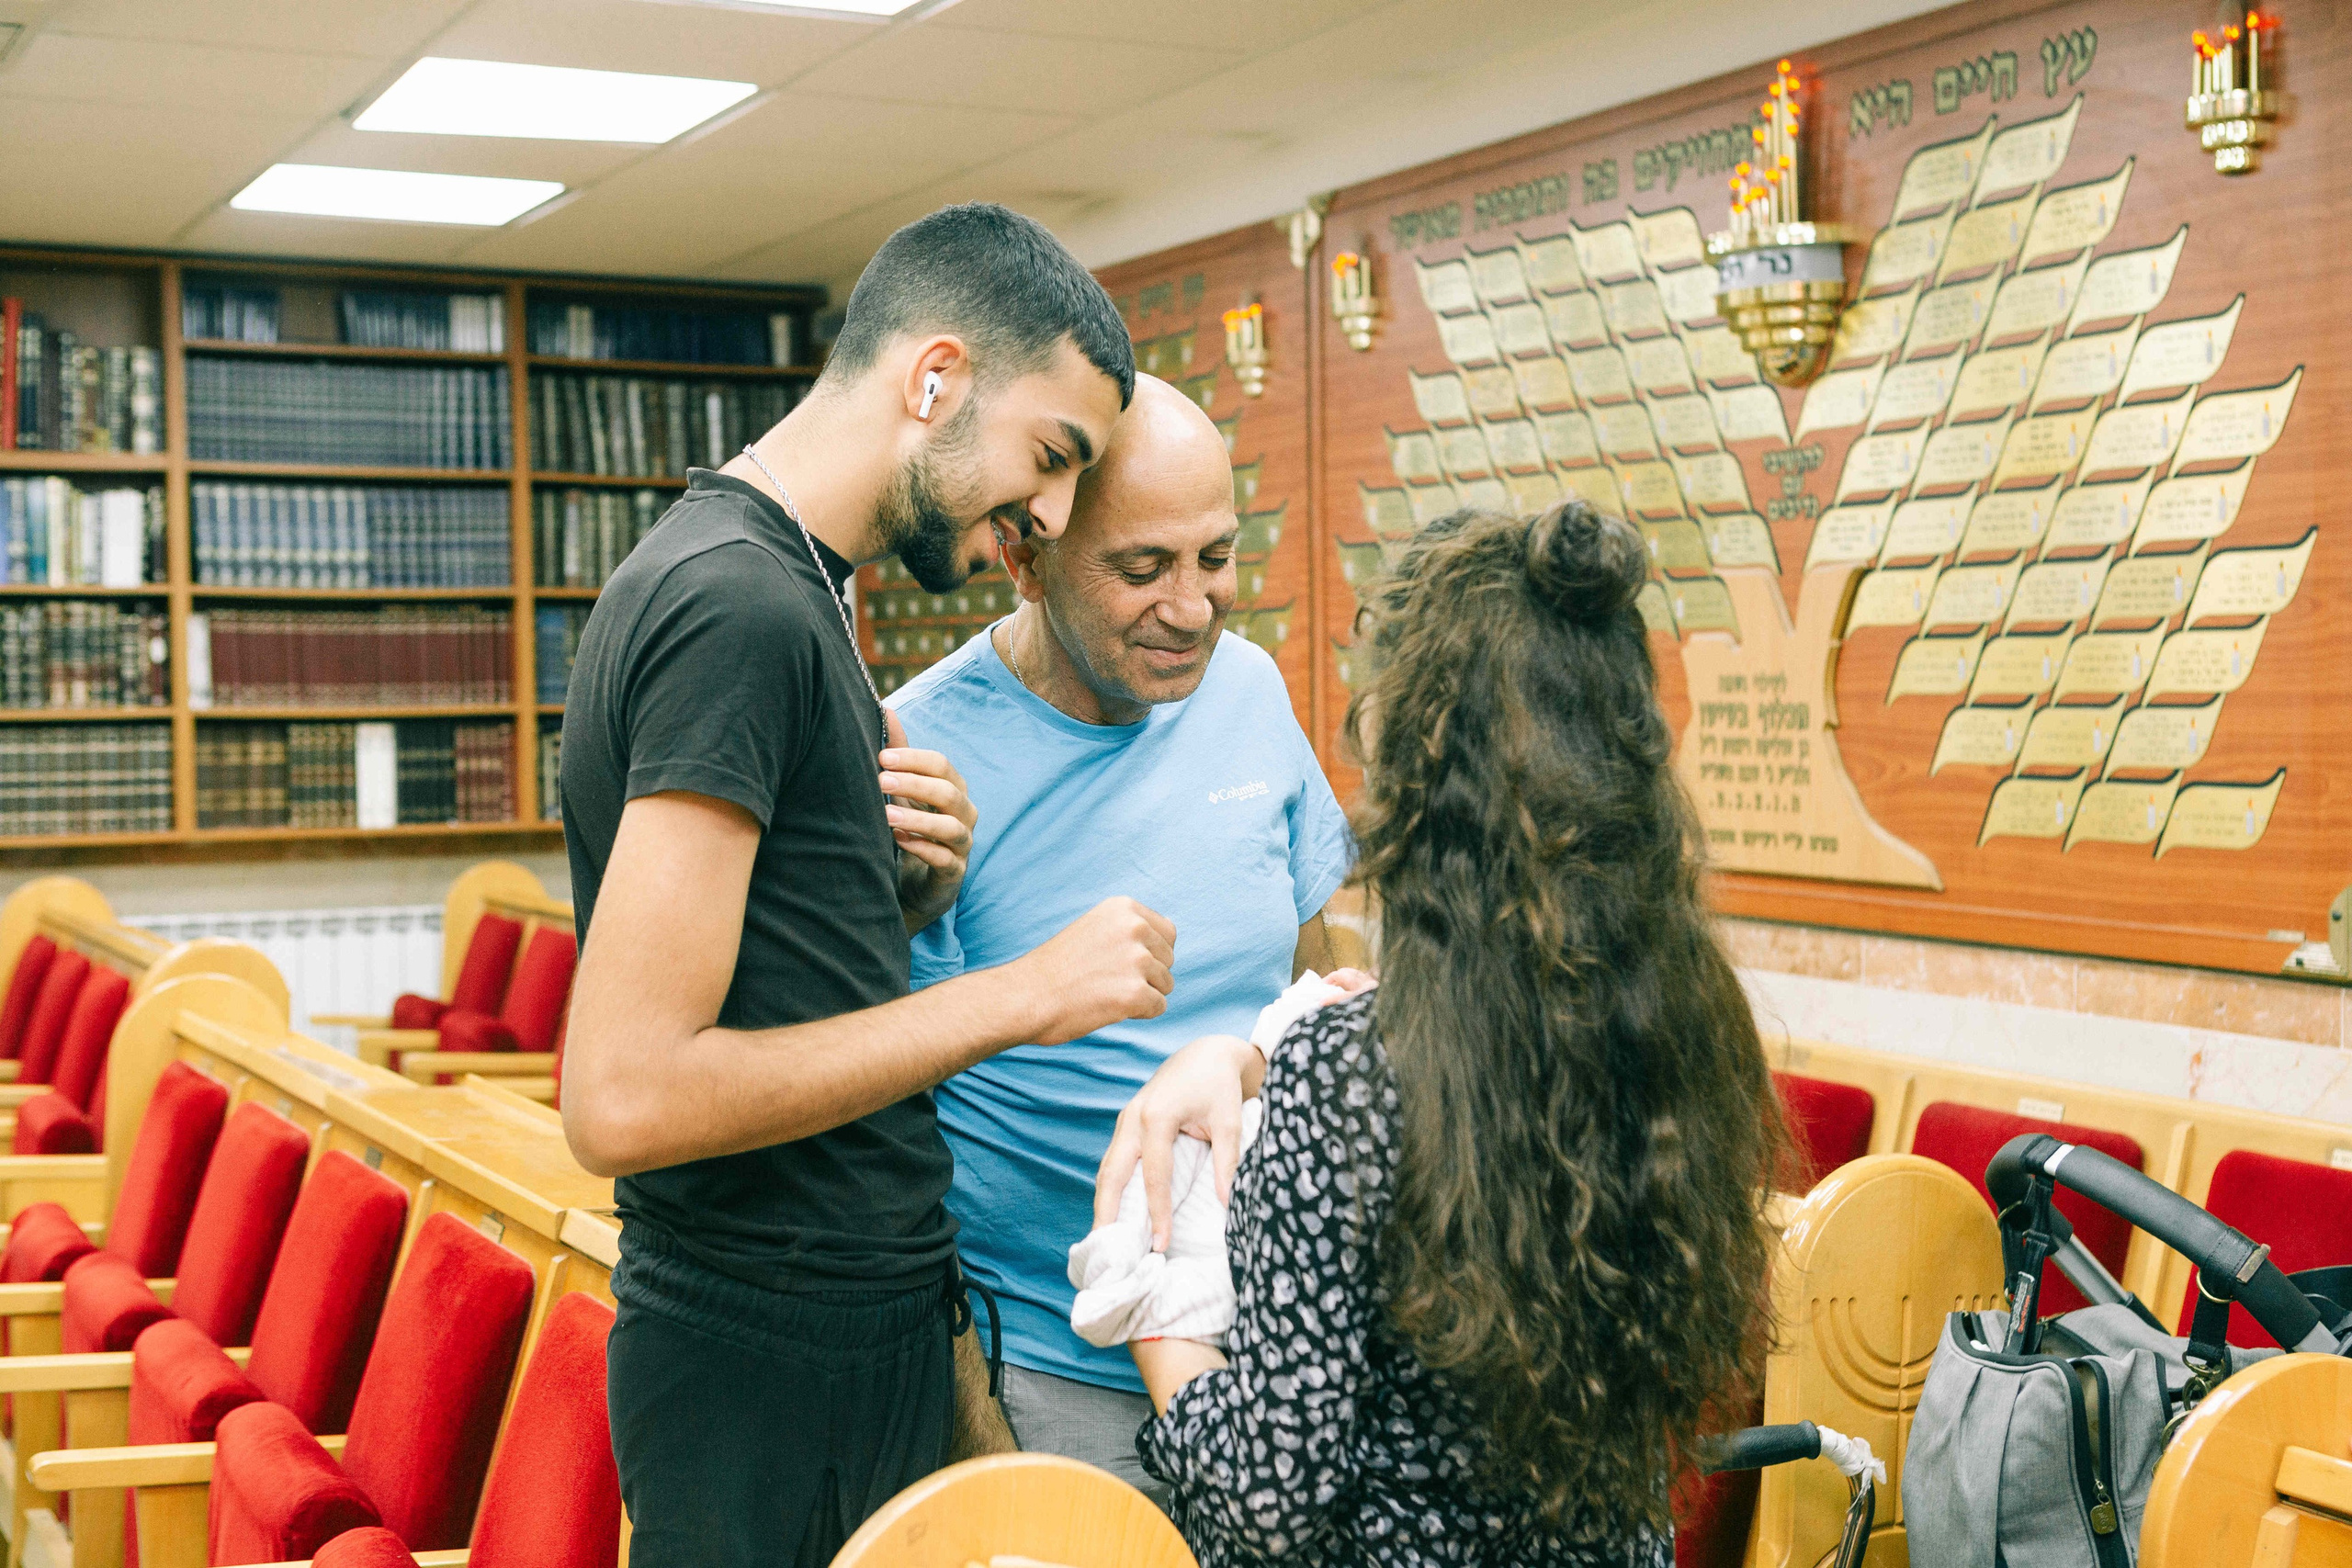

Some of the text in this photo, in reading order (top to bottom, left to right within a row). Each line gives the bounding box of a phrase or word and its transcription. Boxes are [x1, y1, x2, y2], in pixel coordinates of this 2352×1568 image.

[1933, 49, 2018, 116] חיים
[2041, 25, 2098, 98] עץ
[1849, 78, 1913, 140] היא
[1634, 107, 1761, 192] מחזיקים
[1582, 158, 1619, 205] בה
[1758, 253, 1792, 274] נר
[1217, 780, 1268, 801] Columbia
